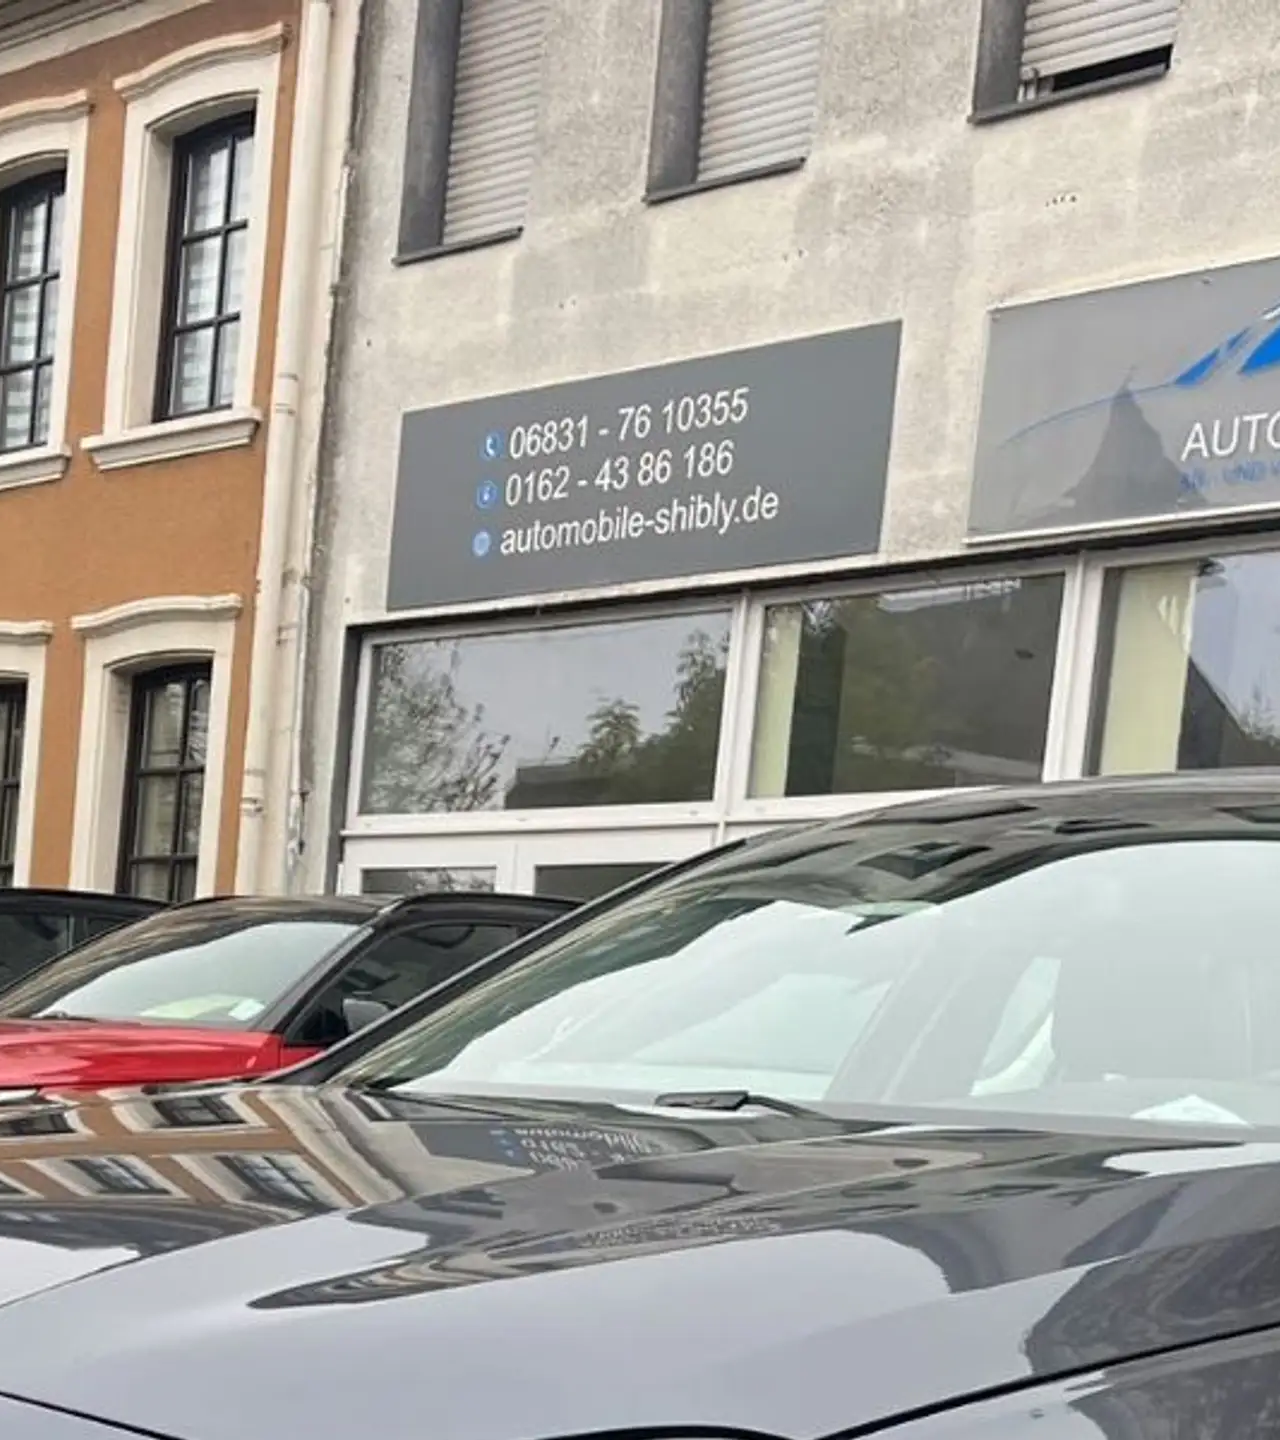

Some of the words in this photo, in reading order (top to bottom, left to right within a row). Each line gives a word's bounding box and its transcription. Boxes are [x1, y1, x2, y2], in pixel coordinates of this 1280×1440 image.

[509, 414, 589, 460] 06831
[598, 427, 611, 437] -
[618, 404, 652, 441] 76
[662, 387, 750, 434] 10355
[505, 466, 570, 507] 0162
[577, 479, 589, 488] -
[594, 456, 629, 492] 43
[637, 449, 673, 487] 86
[683, 439, 734, 480] 186
[500, 485, 780, 556] automobile-shibly.de
